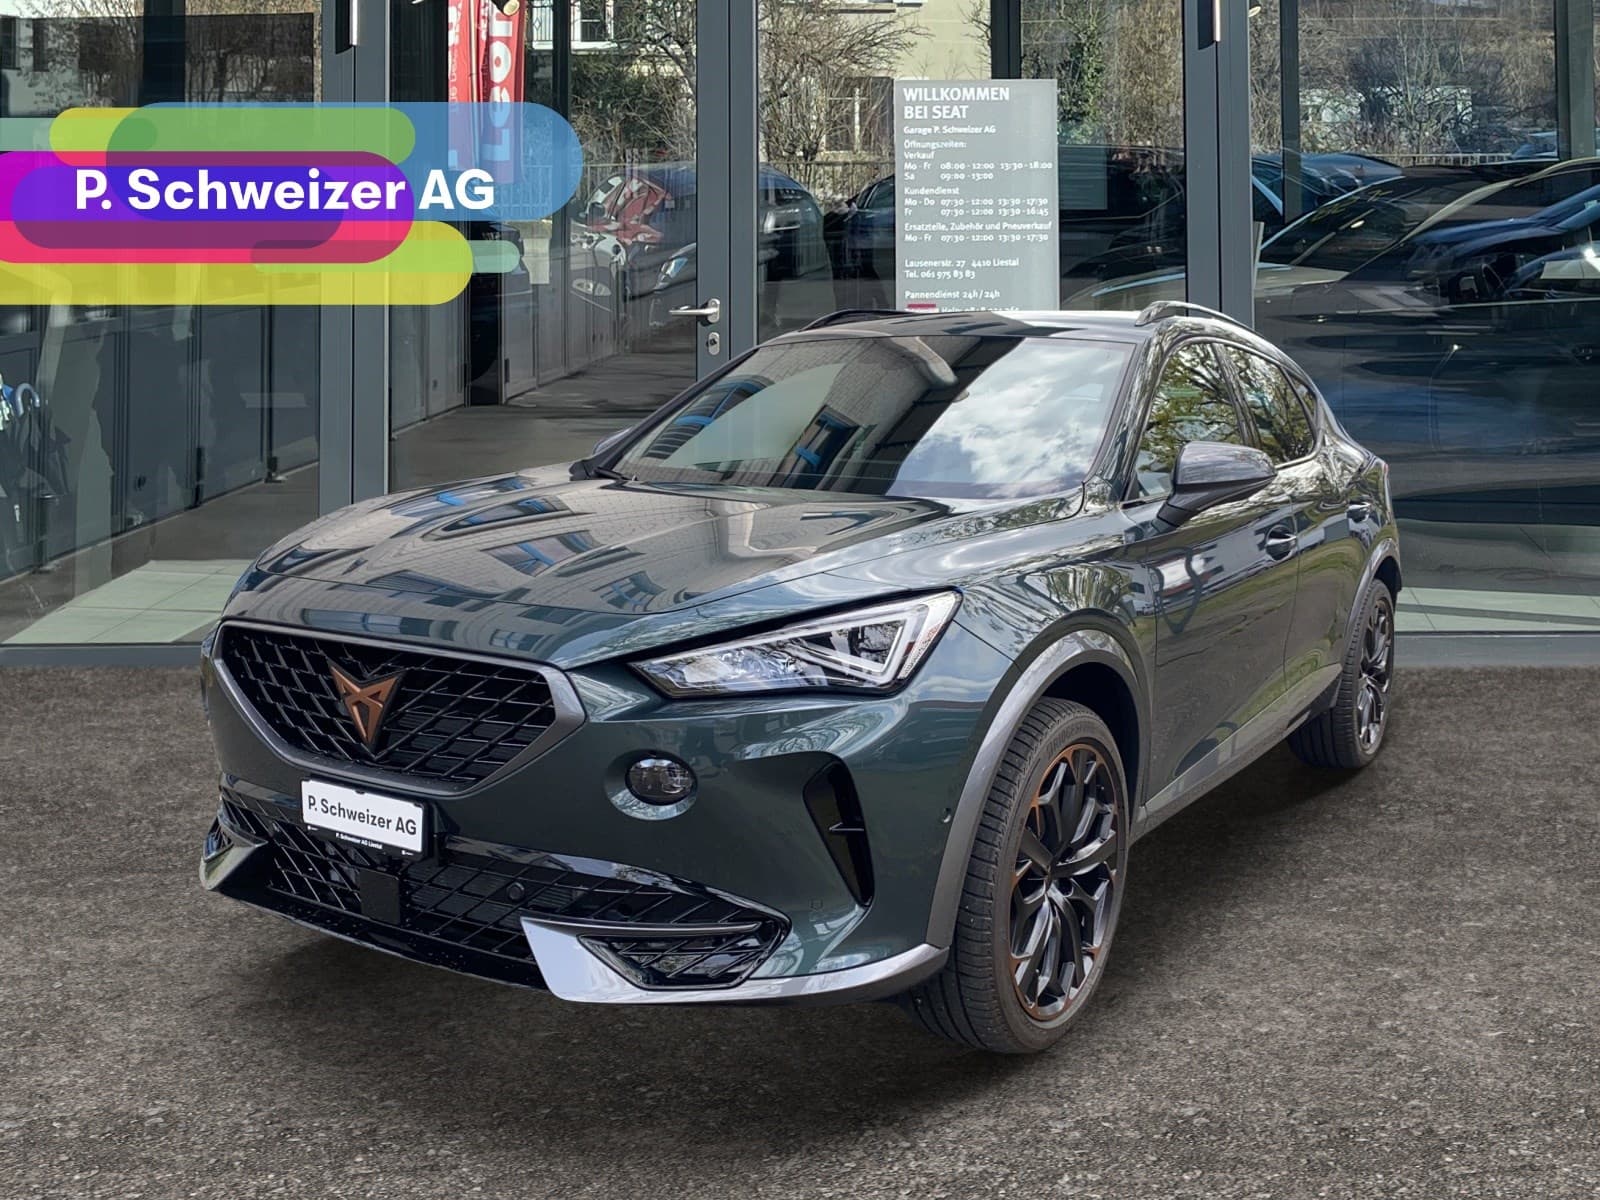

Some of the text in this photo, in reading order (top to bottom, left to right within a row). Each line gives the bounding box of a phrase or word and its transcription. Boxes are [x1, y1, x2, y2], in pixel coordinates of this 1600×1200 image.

[903, 87, 1010, 101] WILLKOMMEN
[904, 105, 969, 119] BEI SEAT
[903, 125, 996, 136] Garage P. Schweizer AG
[903, 139, 967, 150] Öffnungszeiten:
[904, 151, 935, 160] Verkauf
[904, 162, 917, 170] Mo
[923, 162, 931, 170] Fr
[940, 162, 965, 170] 08:00
[972, 162, 995, 170] 12:00
[1000, 162, 1023, 171] 13:30
[1029, 161, 1053, 169] 18:00
[940, 173, 965, 181] 09:00
[904, 186, 960, 195] Kundendienst
[904, 198, 917, 206] Mo
[924, 198, 935, 206] Do
[940, 198, 964, 206] 07:30
[998, 198, 1021, 206] 13:30
[1026, 198, 1049, 206] 17:30
[904, 208, 912, 216] Fr
[940, 208, 964, 216] 07:30
[998, 208, 1021, 216] 13:30
[1026, 208, 1049, 216] 16:45
[904, 222, 1052, 231] Ersatzteile, Zubehör und Pneuverkauf
[904, 234, 917, 242] Mo
[940, 234, 964, 242] 07:30
[998, 234, 1021, 242] 13:30
[1026, 234, 1049, 242] 17:30
[904, 258, 1019, 268] Lausenerstr. 27 4410 Liestal
[904, 270, 976, 279] Tel. 061 975 83 83
[904, 290, 960, 299] Pannendienst
[308, 795, 417, 835] P. Schweizer AG
